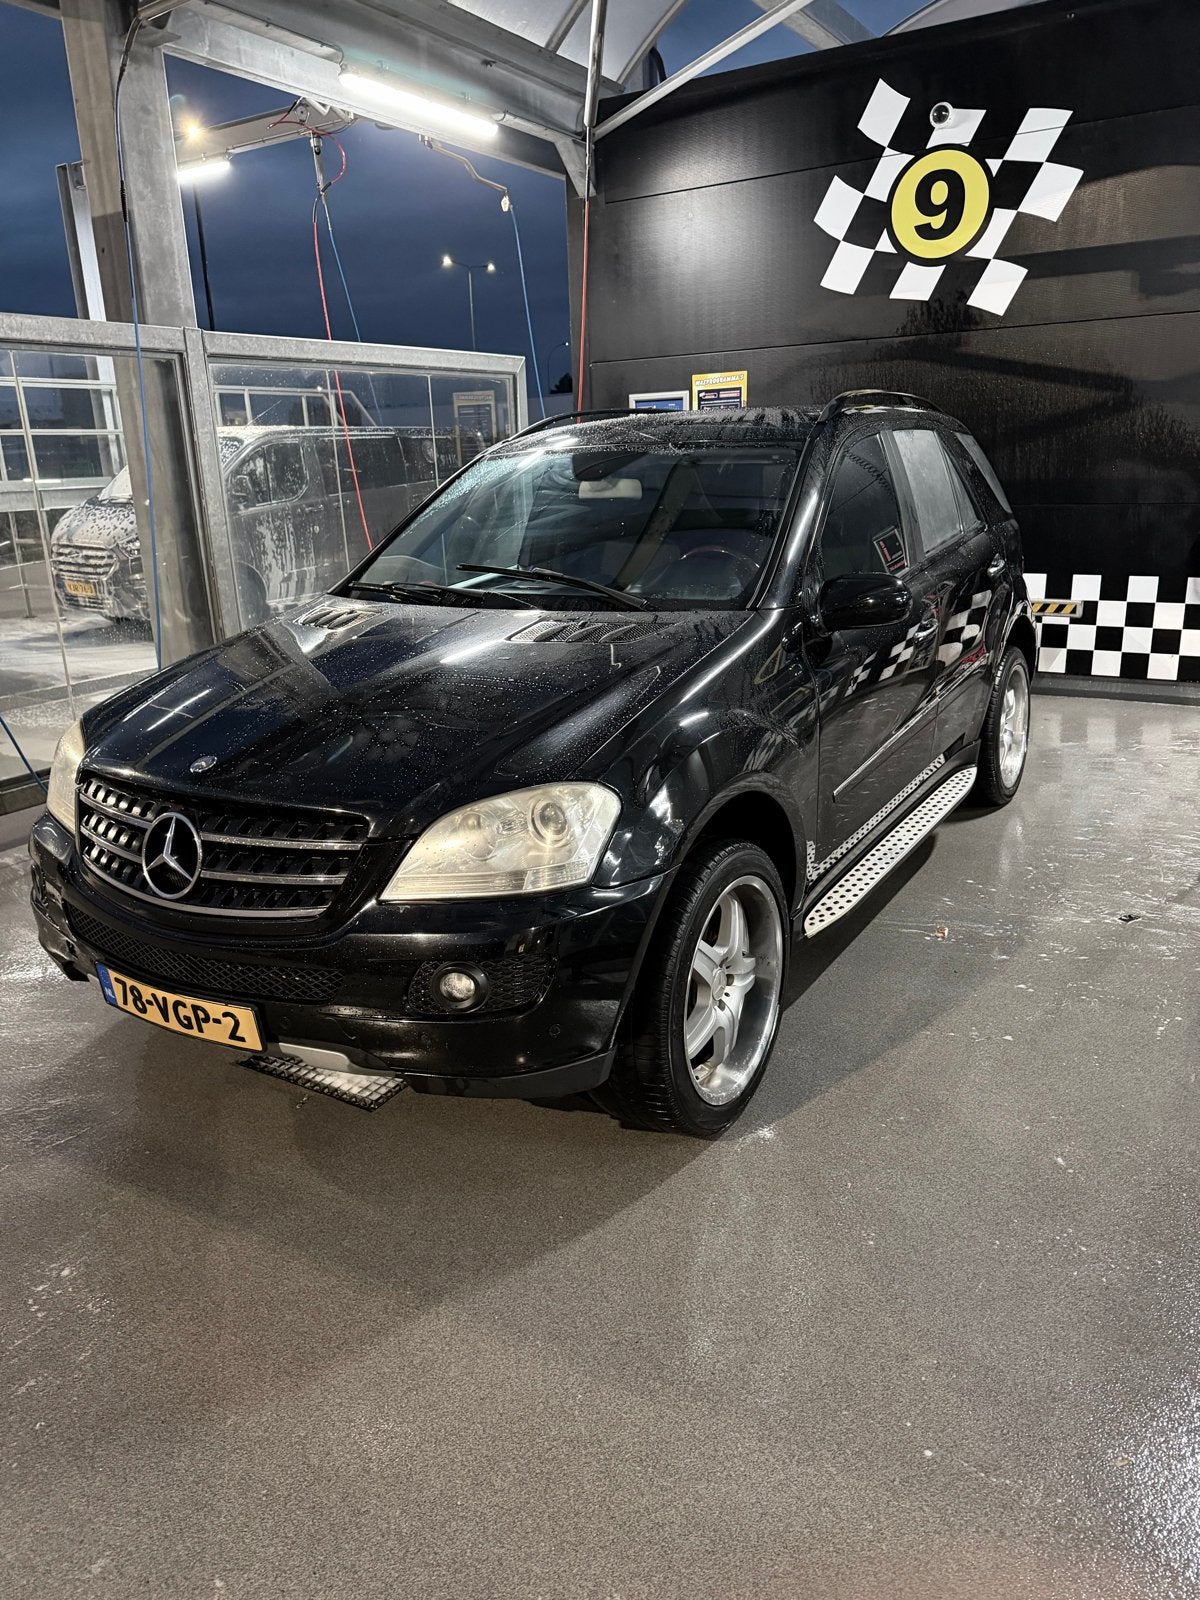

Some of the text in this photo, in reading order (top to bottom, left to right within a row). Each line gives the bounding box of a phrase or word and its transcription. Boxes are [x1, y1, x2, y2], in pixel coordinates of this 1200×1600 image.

[914, 169, 965, 240] 9
[105, 987, 115, 998] NL
[114, 976, 246, 1042] 78-VGP-2
